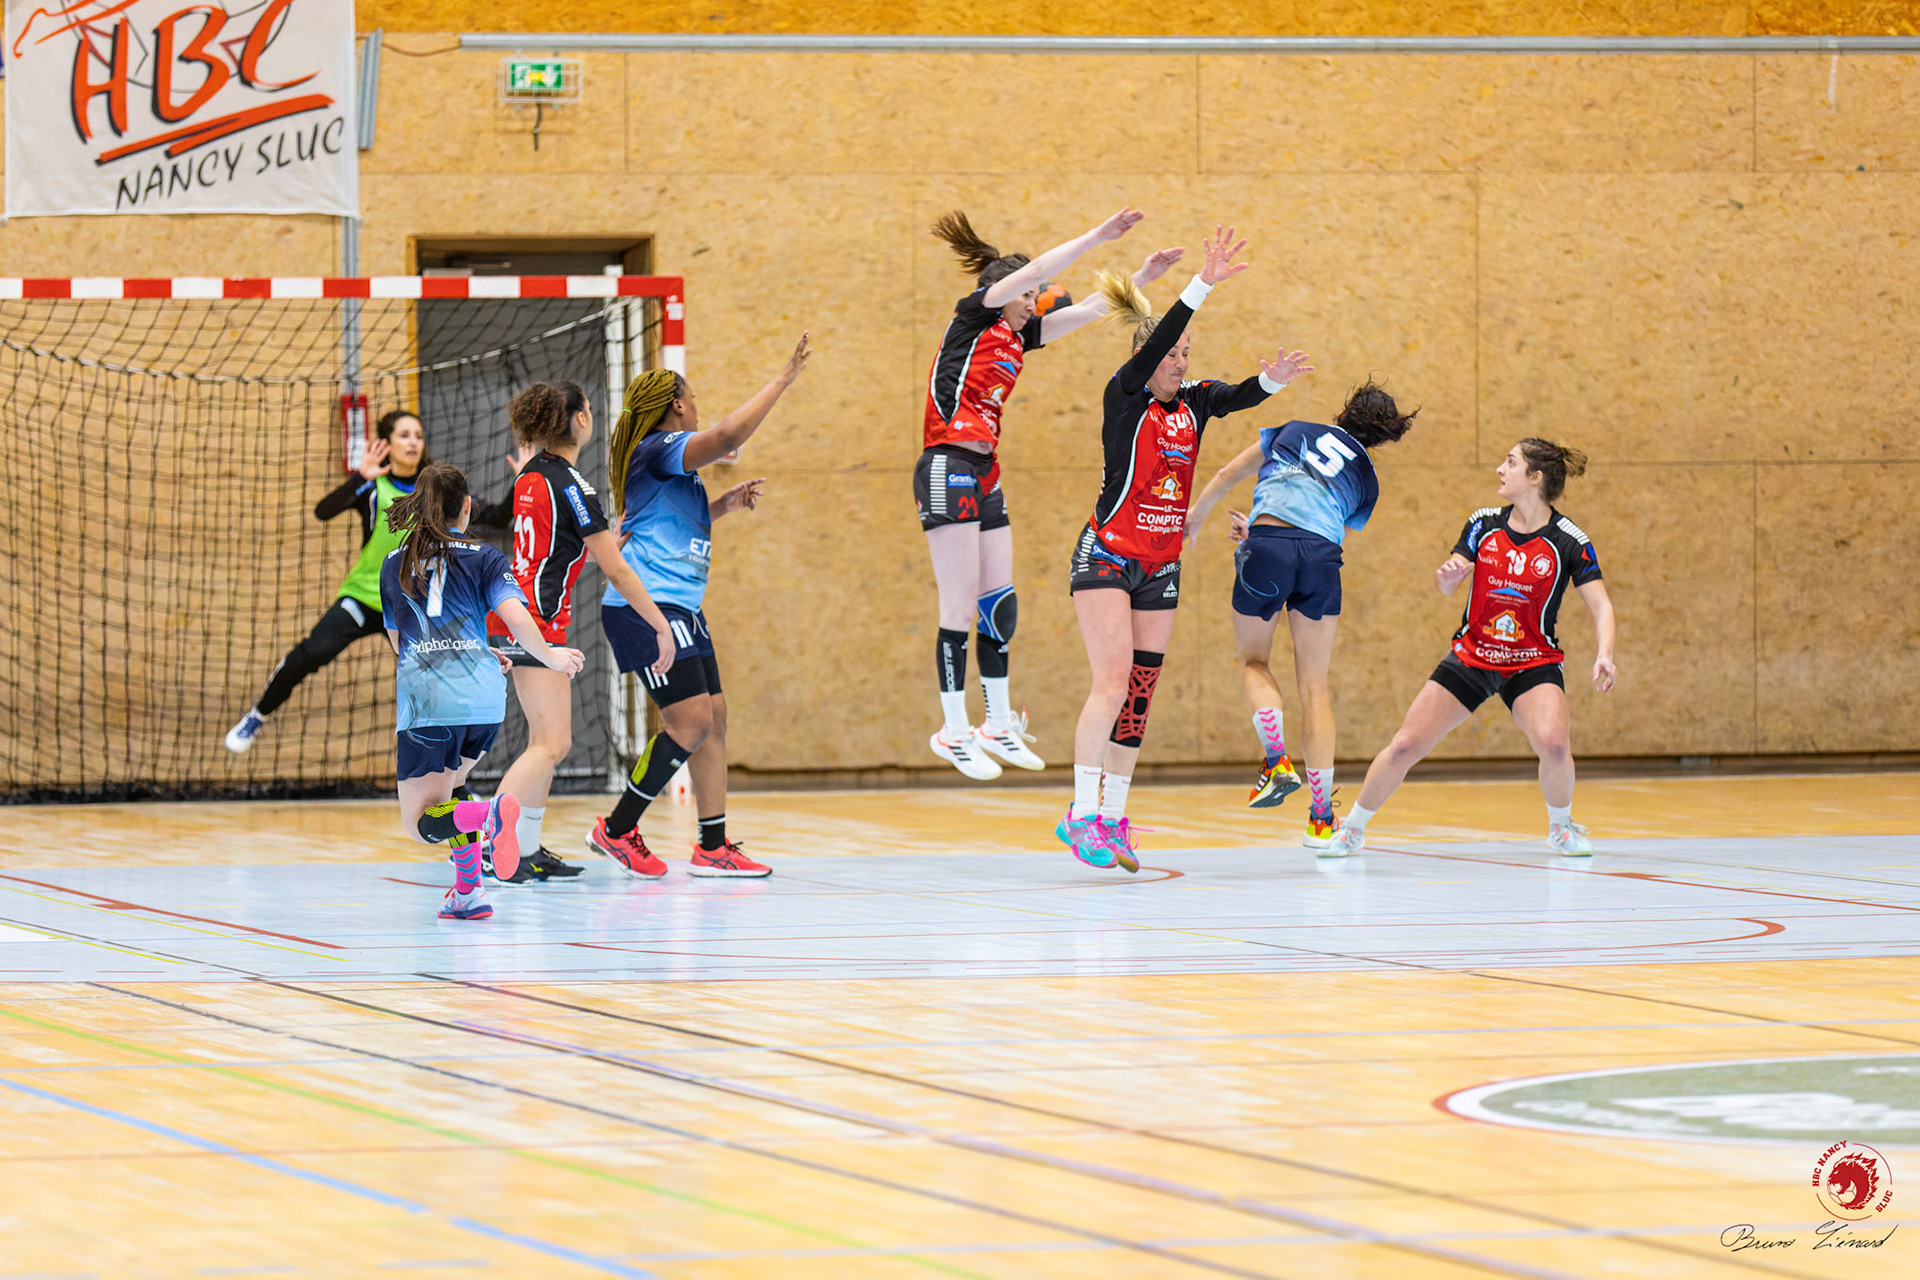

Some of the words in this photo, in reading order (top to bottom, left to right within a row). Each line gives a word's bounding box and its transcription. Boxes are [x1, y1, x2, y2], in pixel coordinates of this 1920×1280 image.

[70, 0, 325, 144] HBC
[115, 143, 244, 210] NANCY
[256, 117, 344, 176] SLUC
[1305, 432, 1358, 478] 5
[1488, 575, 1503, 588] Guy
[1504, 579, 1533, 592] Hoquet
